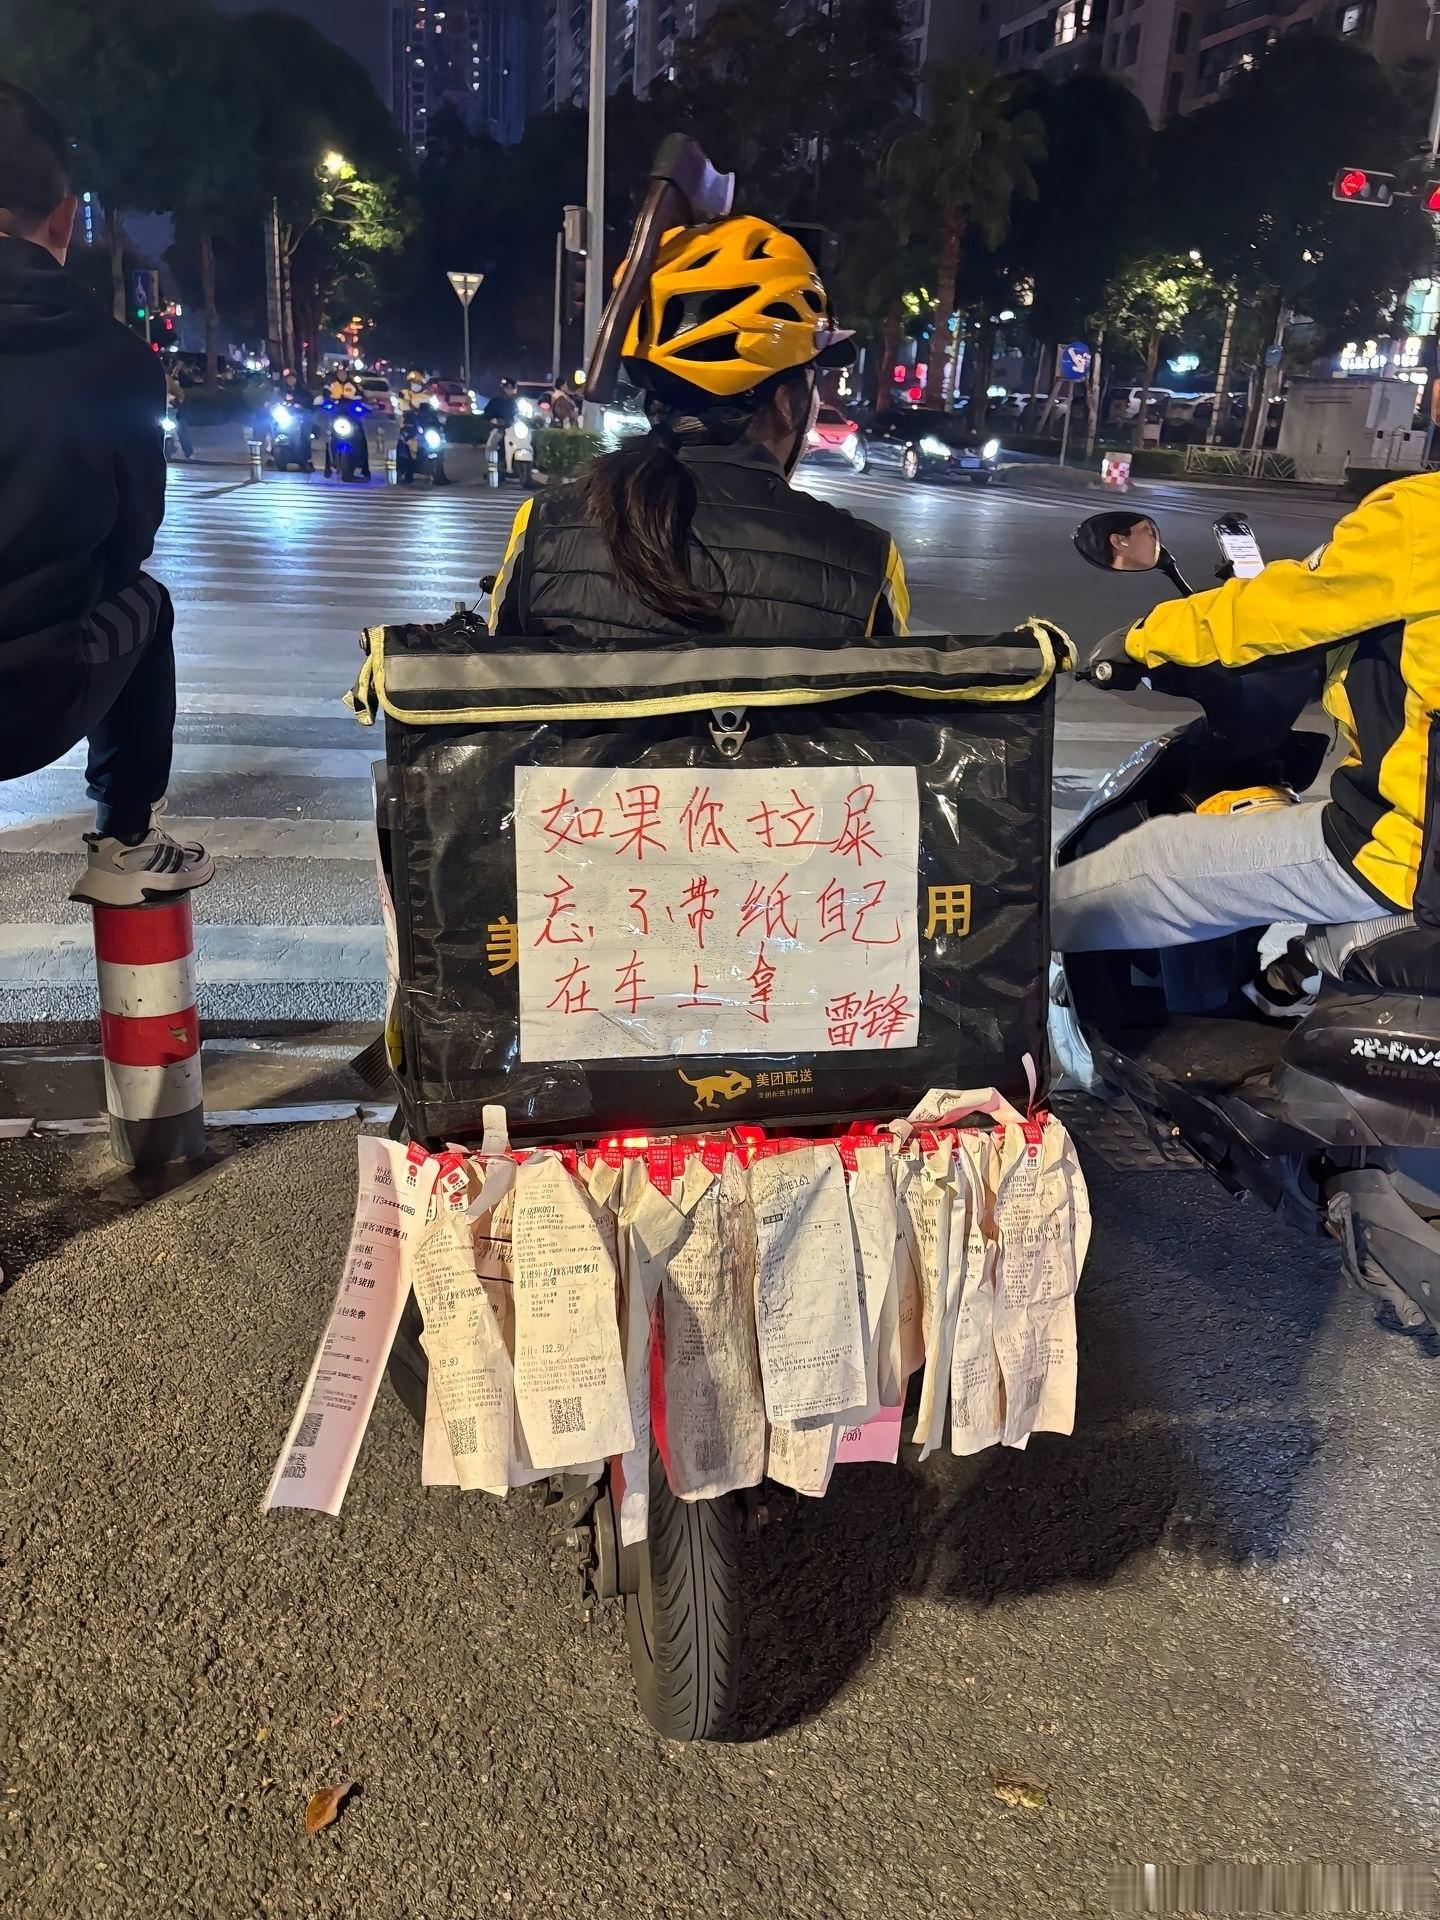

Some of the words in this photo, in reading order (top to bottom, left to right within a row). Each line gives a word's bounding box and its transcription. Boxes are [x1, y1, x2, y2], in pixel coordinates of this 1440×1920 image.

[541, 785, 882, 866] 如果你拉屎
[534, 873, 901, 948] 忘了带纸自己
[925, 884, 971, 938] 用
[546, 941, 777, 1023] 在车上拿
[825, 984, 914, 1049] 雷锋
[757, 1069, 813, 1087] 美团配送
